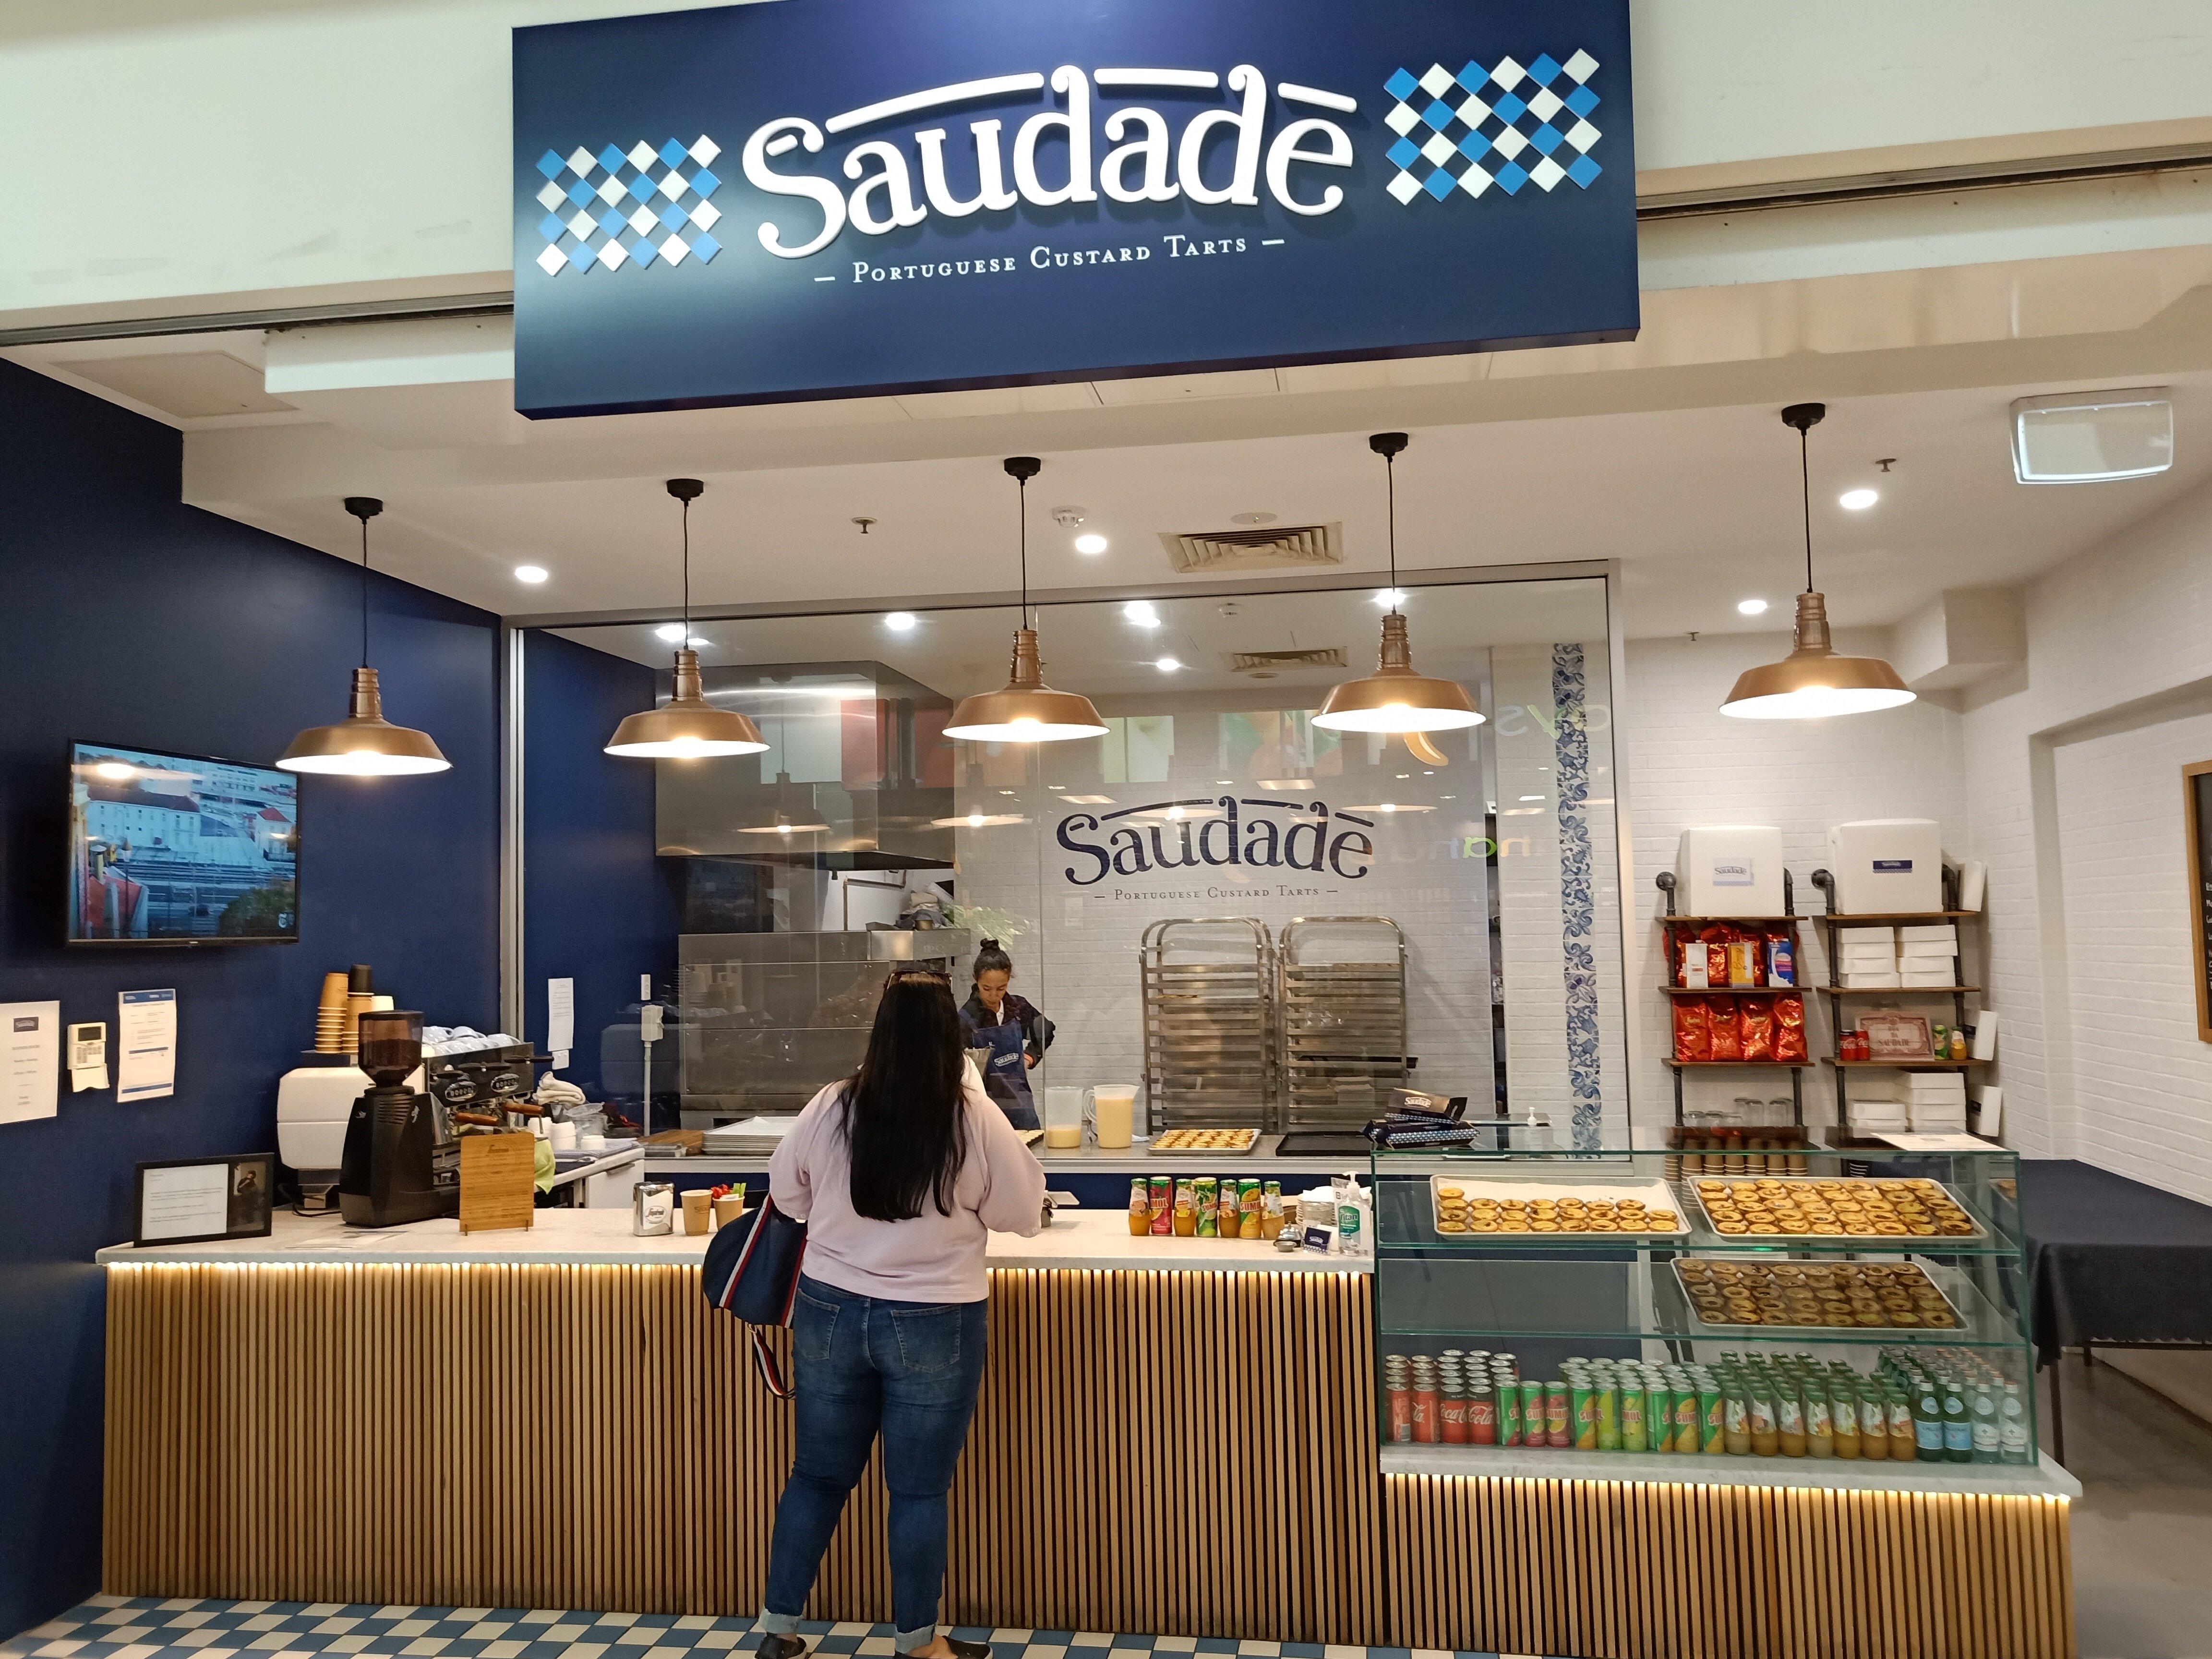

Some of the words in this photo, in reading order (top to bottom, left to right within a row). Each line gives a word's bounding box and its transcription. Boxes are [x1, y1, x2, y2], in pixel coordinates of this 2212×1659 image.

[742, 64, 1357, 258] Saudade
[853, 256, 1016, 283] PORTUGUESE
[1030, 245, 1151, 269] CUSTARD
[1163, 234, 1247, 258] TARTS
[1057, 795, 1374, 885] Saudade
[1115, 889, 1200, 901] PORTUGUESE
[1207, 886, 1269, 899] CUSTARD
[1276, 885, 1319, 896] TARTS
